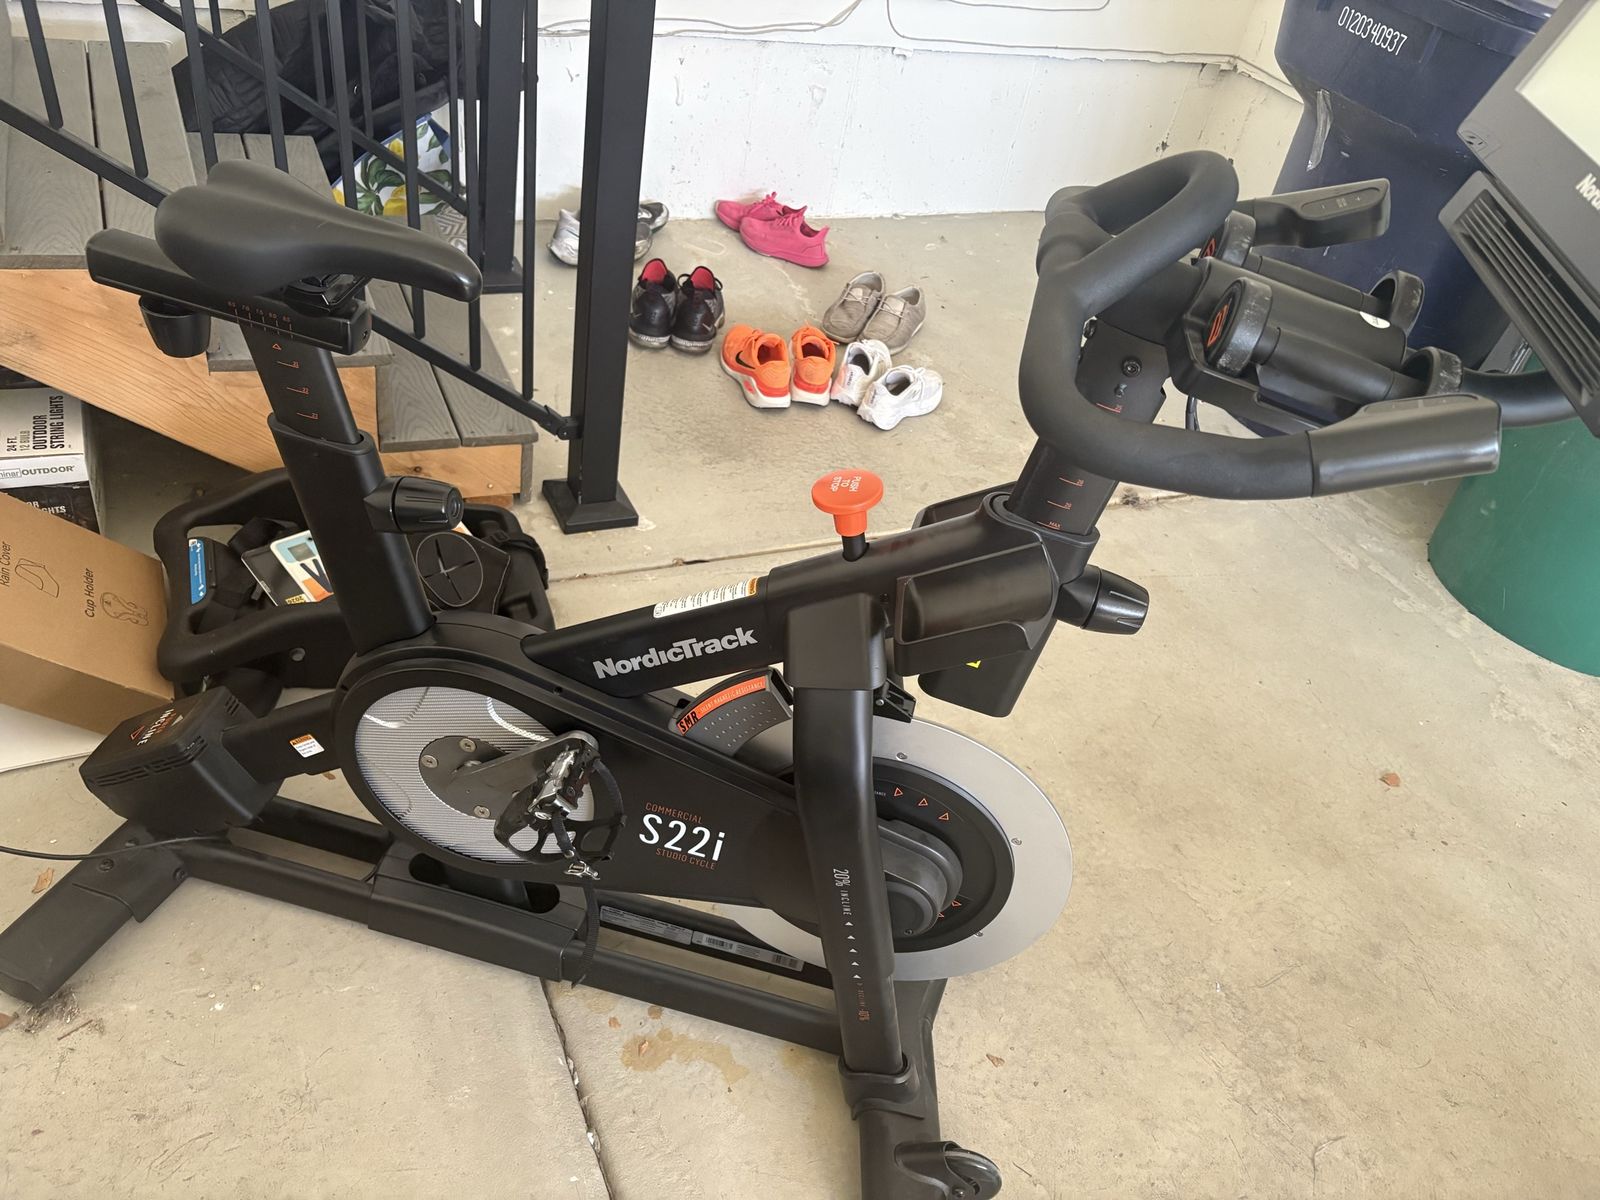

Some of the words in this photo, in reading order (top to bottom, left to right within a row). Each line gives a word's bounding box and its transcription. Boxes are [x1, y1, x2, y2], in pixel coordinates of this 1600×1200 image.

[1337, 6, 1408, 56] 0120340937
[48, 395, 64, 420] LIGHTS
[32, 413, 48, 450] OUTDOOR
[49, 420, 65, 449] STRING
[6, 441, 17, 452] 24
[20, 443, 30, 452] 12
[22, 465, 75, 476] OUTDOOR
[1048, 520, 1061, 529] MAX
[0, 540, 12, 567] Cover
[0, 567, 11, 588] Rain
[83, 567, 96, 598] Holder
[84, 598, 97, 618] Cup
[592, 627, 758, 680] NordicTrack
[679, 710, 699, 733] SMR
[645, 802, 703, 825] COMMERCIAL
[638, 813, 726, 862] S22i
[655, 847, 688, 862] STUDIO
[688, 856, 717, 871] CYCLE
[833, 868, 851, 887] 20%
[840, 889, 852, 916] INCLINE
